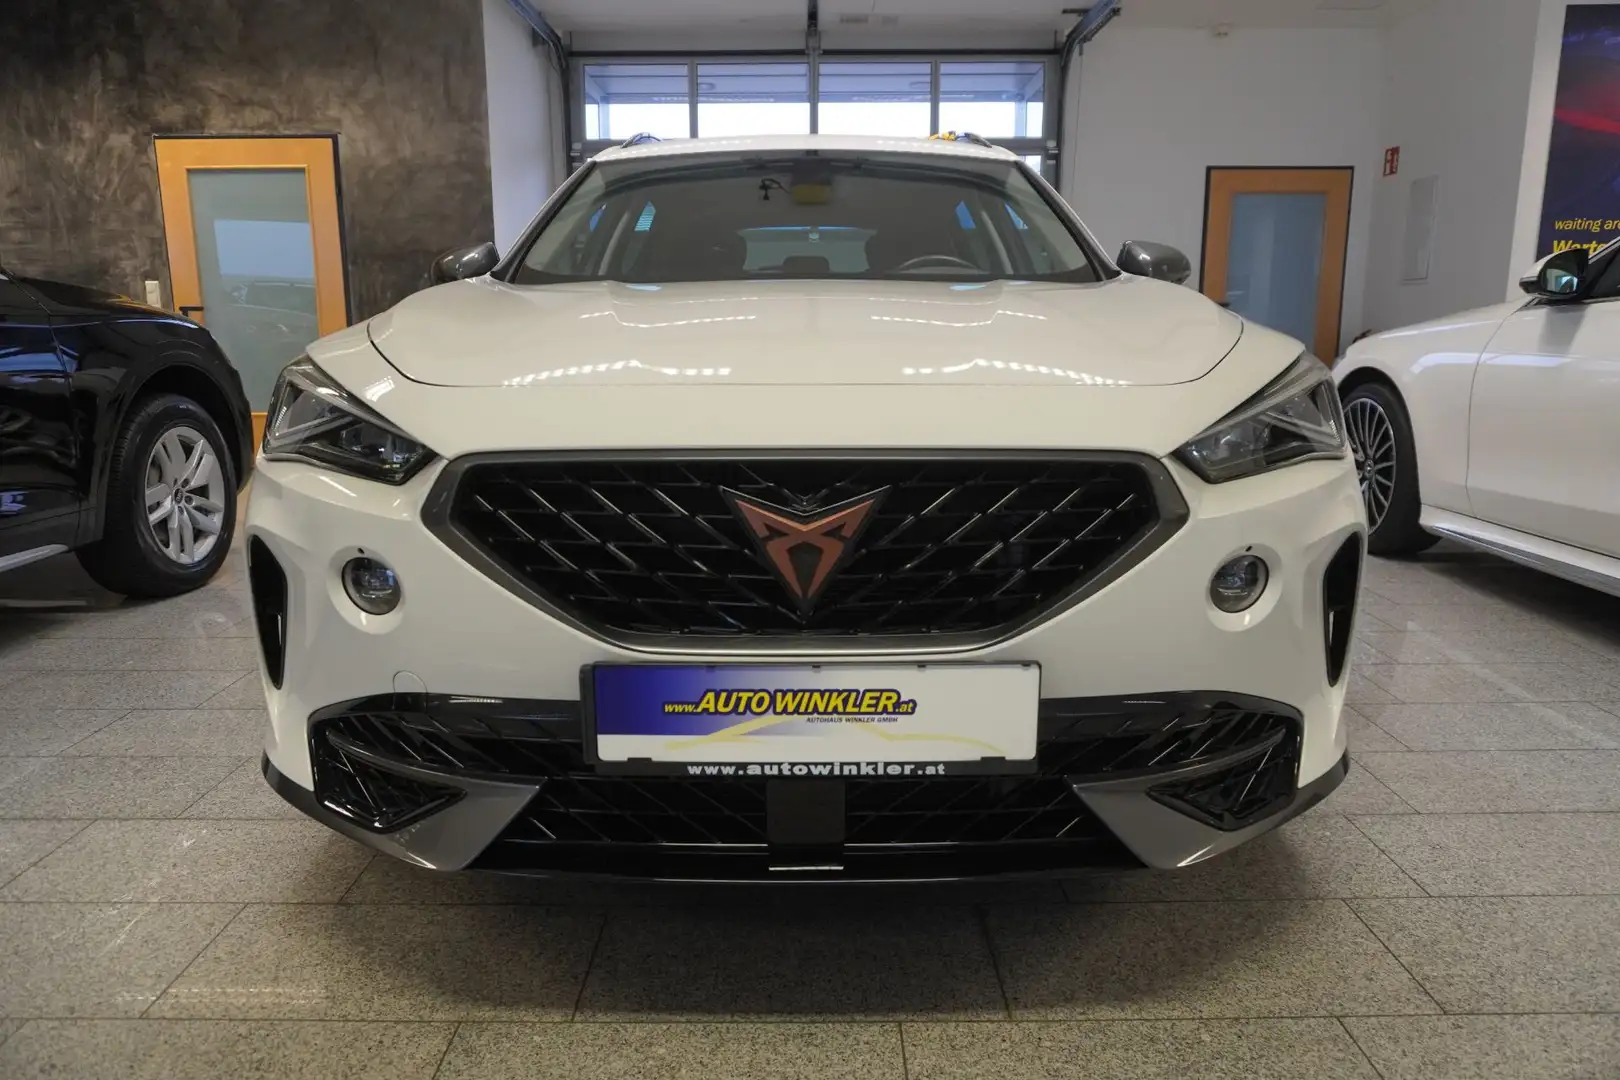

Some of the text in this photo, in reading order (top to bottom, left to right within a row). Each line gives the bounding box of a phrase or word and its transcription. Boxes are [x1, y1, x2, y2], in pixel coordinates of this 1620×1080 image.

[1555, 218, 1602, 232] waiting
[806, 716, 843, 724] AUTOHAUS
[844, 716, 876, 724] WINKLER
[687, 761, 946, 776] www.autowinkler.at
